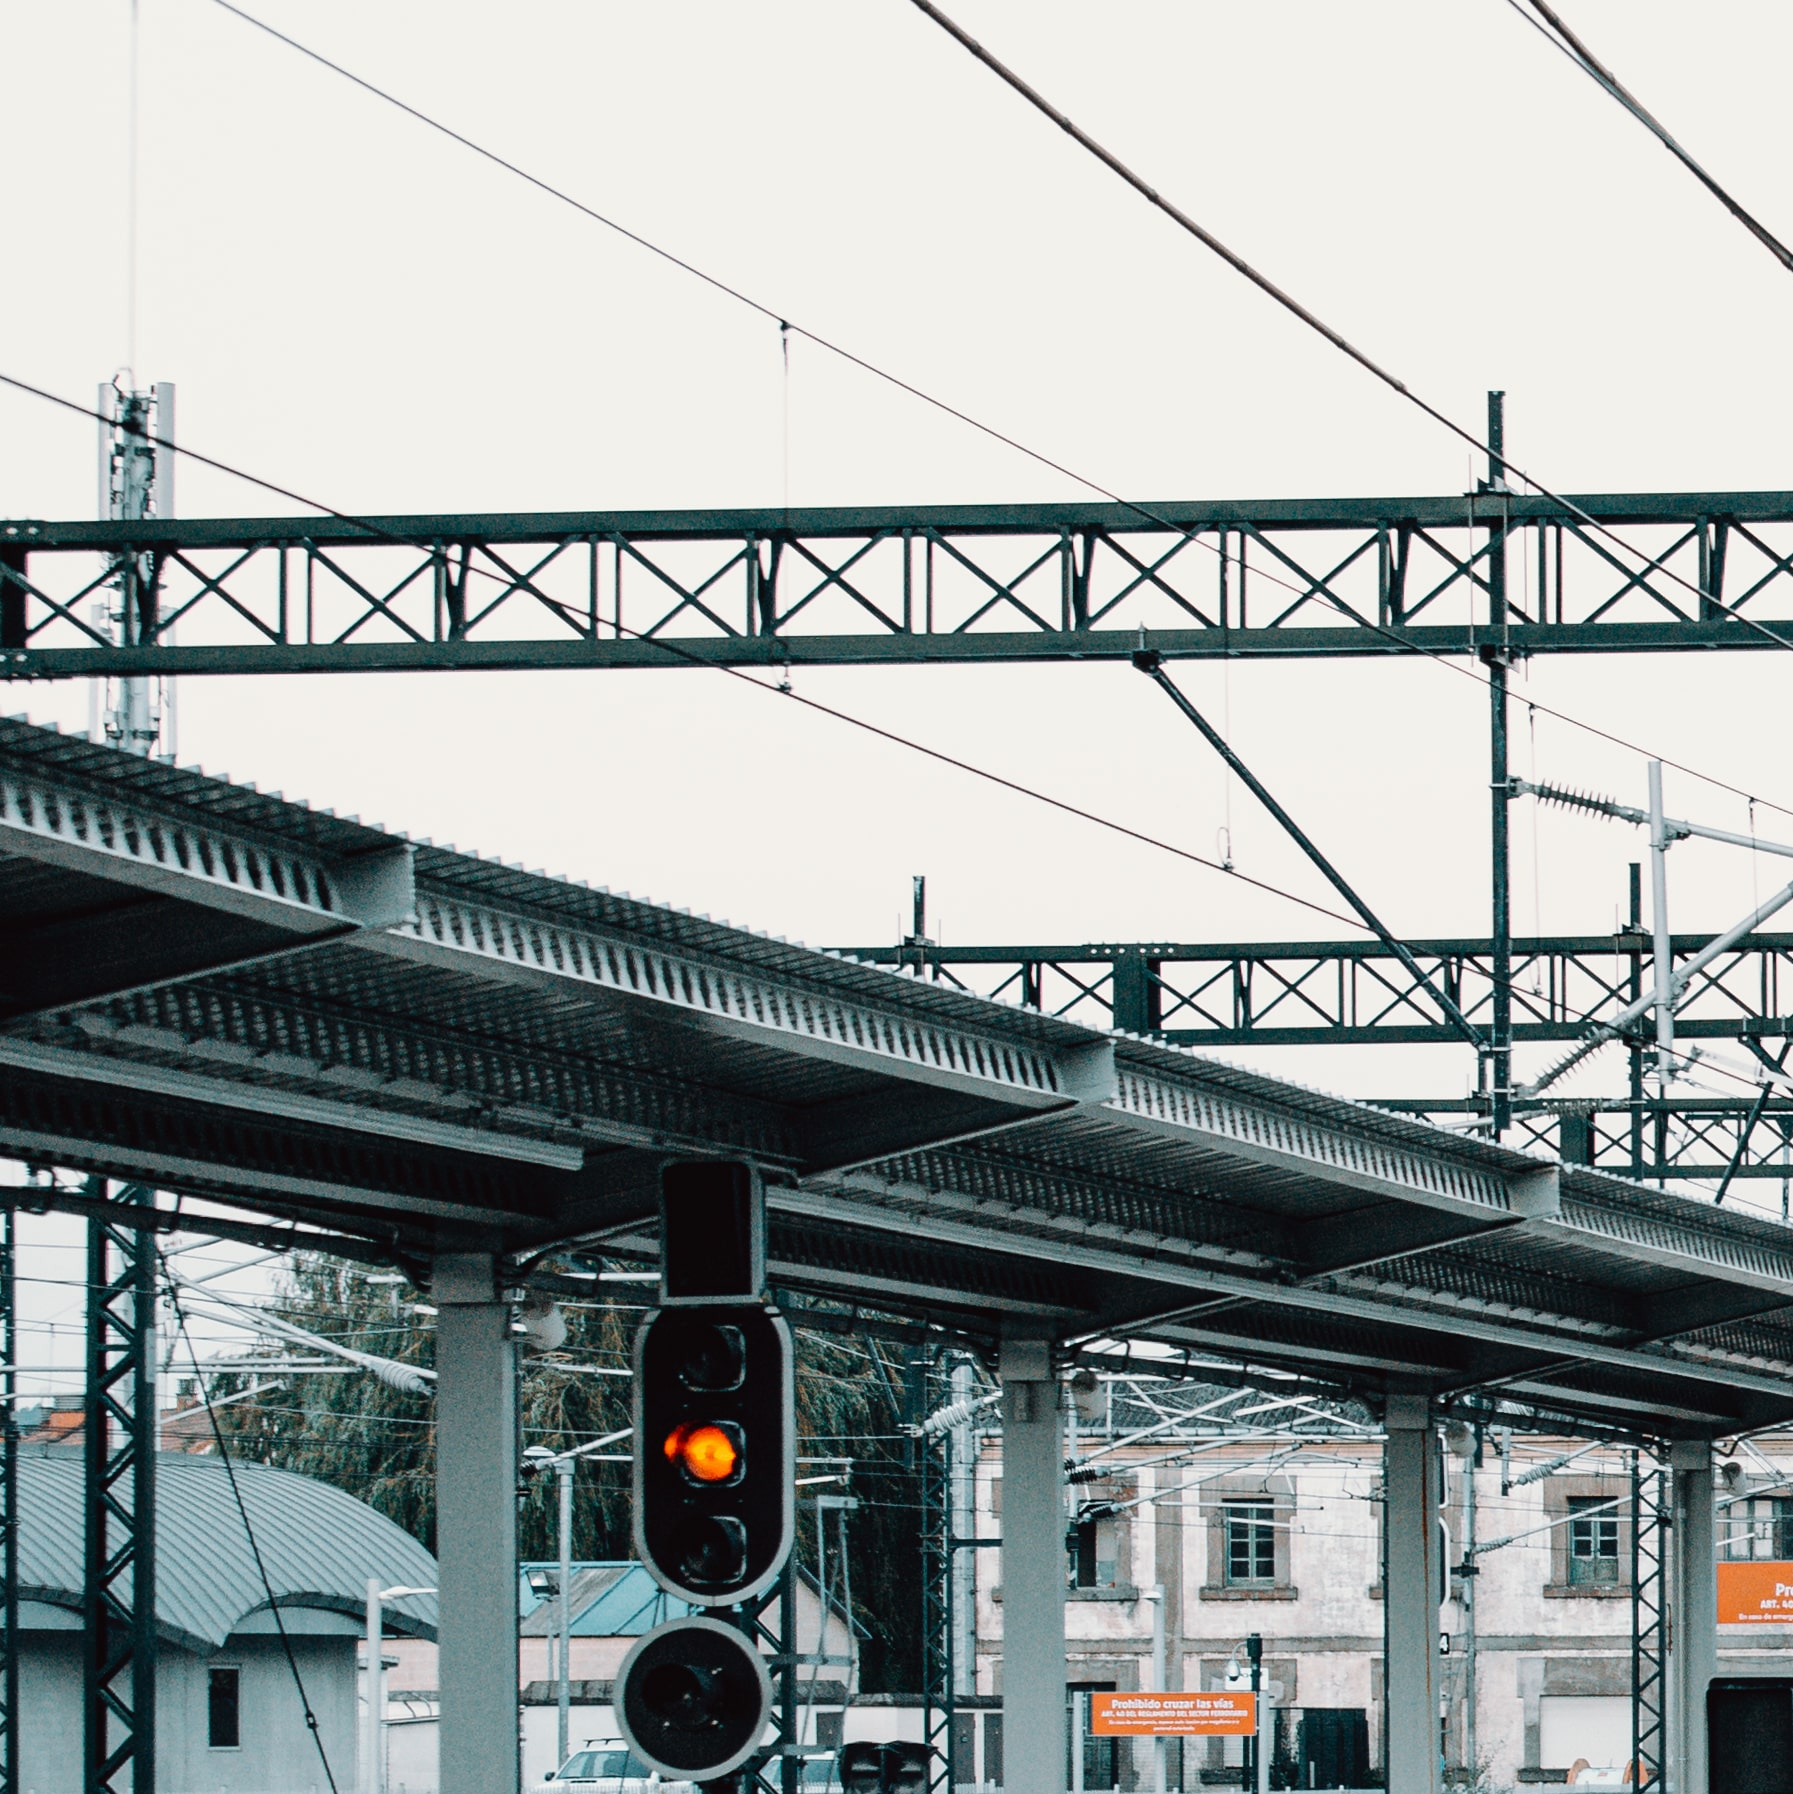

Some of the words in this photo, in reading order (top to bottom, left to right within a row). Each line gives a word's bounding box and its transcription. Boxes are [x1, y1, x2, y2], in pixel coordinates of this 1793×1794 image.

[1111, 1699, 1161, 1709] Prohibido
[1163, 1700, 1195, 1709] cruzar
[1196, 1699, 1211, 1709] las
